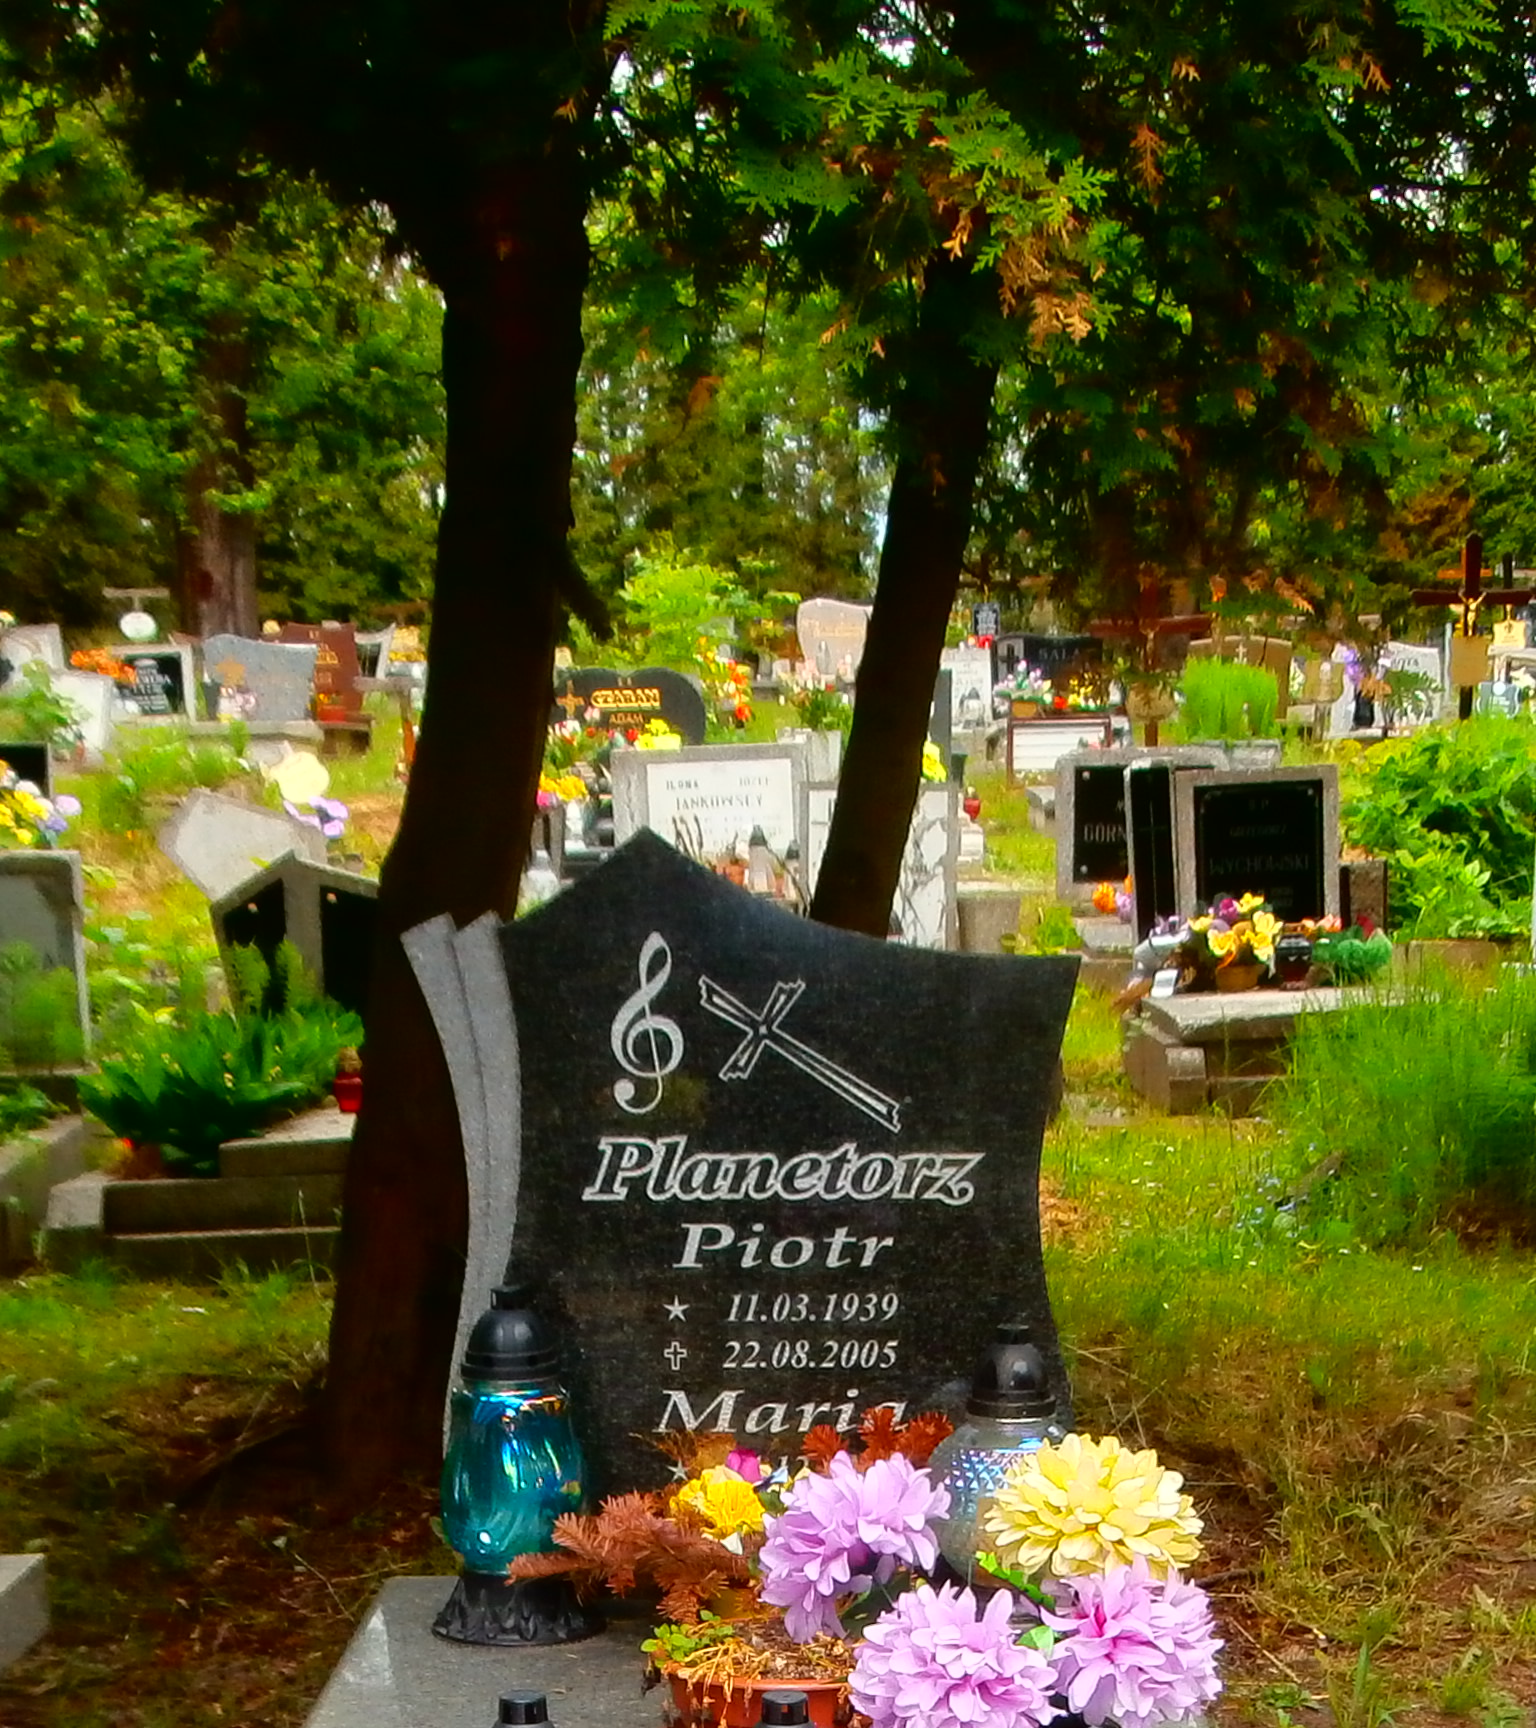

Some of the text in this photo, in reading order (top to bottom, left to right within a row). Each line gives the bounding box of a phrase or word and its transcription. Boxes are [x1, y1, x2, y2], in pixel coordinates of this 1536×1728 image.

[583, 1135, 985, 1206] Planetorz
[672, 1222, 895, 1270] Piotr
[725, 1291, 901, 1324] 11.03.1939
[721, 1340, 900, 1371] 22.08.2005
